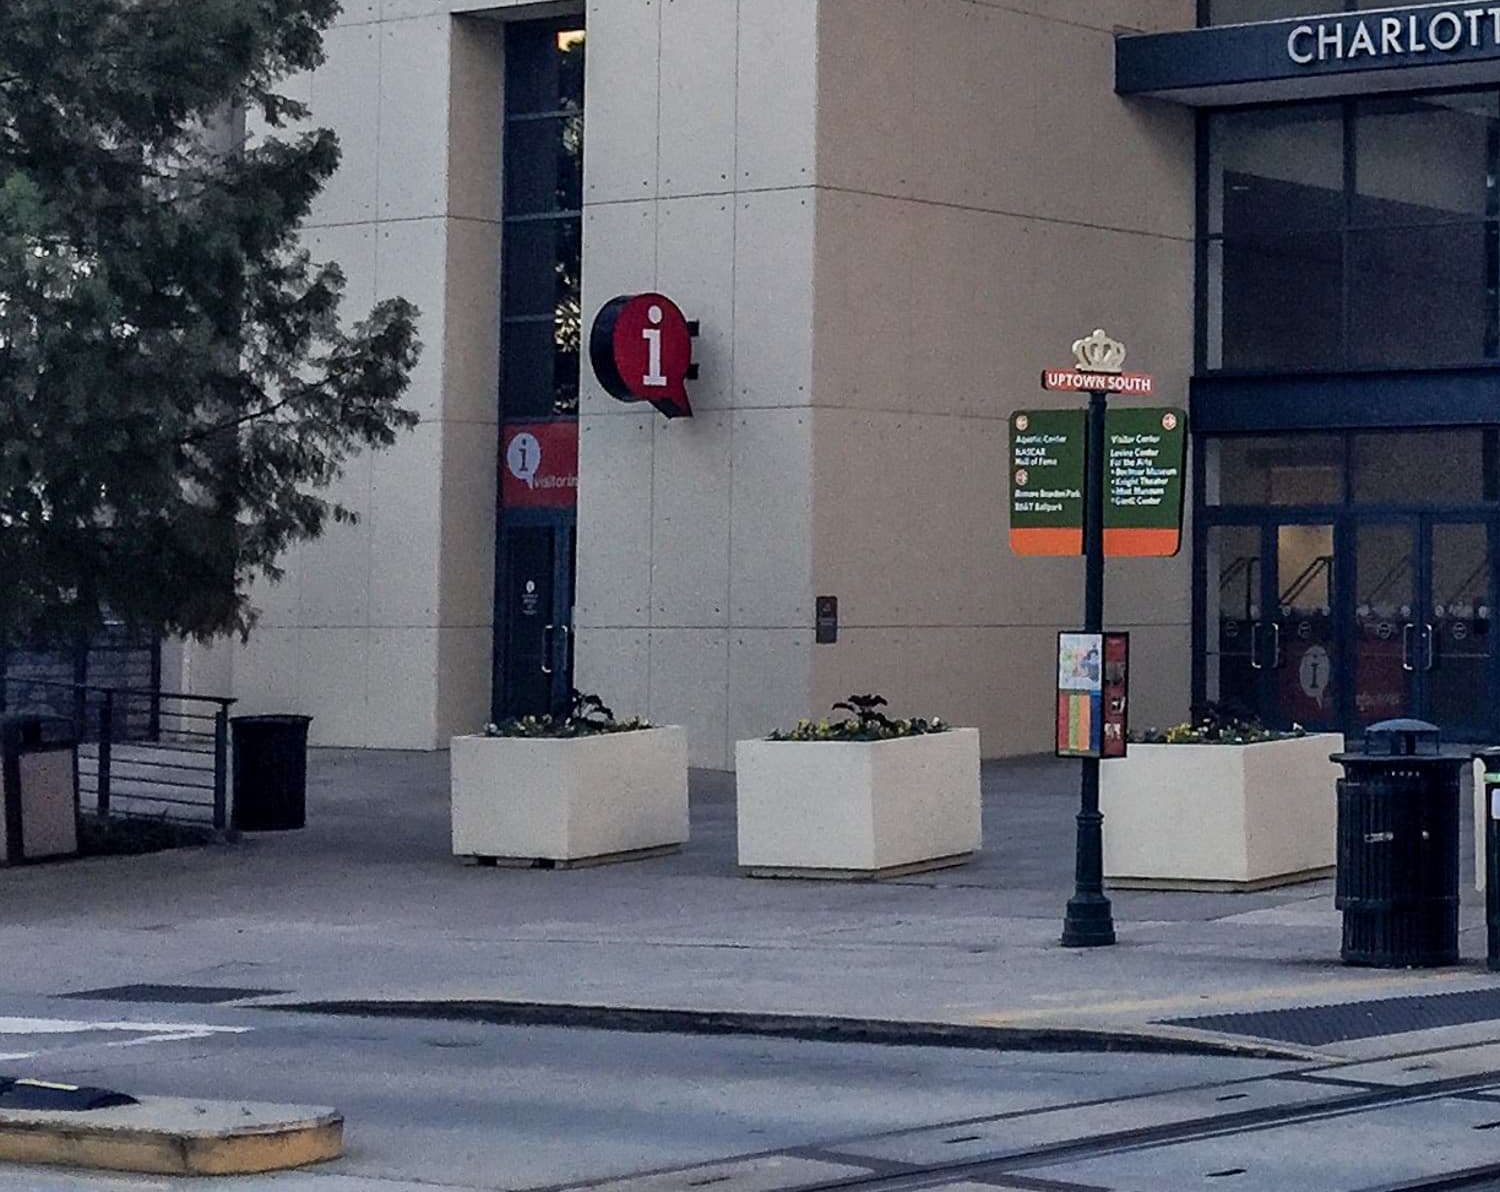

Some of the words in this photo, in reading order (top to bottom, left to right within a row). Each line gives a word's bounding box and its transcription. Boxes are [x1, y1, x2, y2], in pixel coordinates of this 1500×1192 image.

[1048, 373, 1105, 388] UPTOWN
[1107, 376, 1152, 391] SOUTH
[1015, 447, 1046, 456] NASCAR
